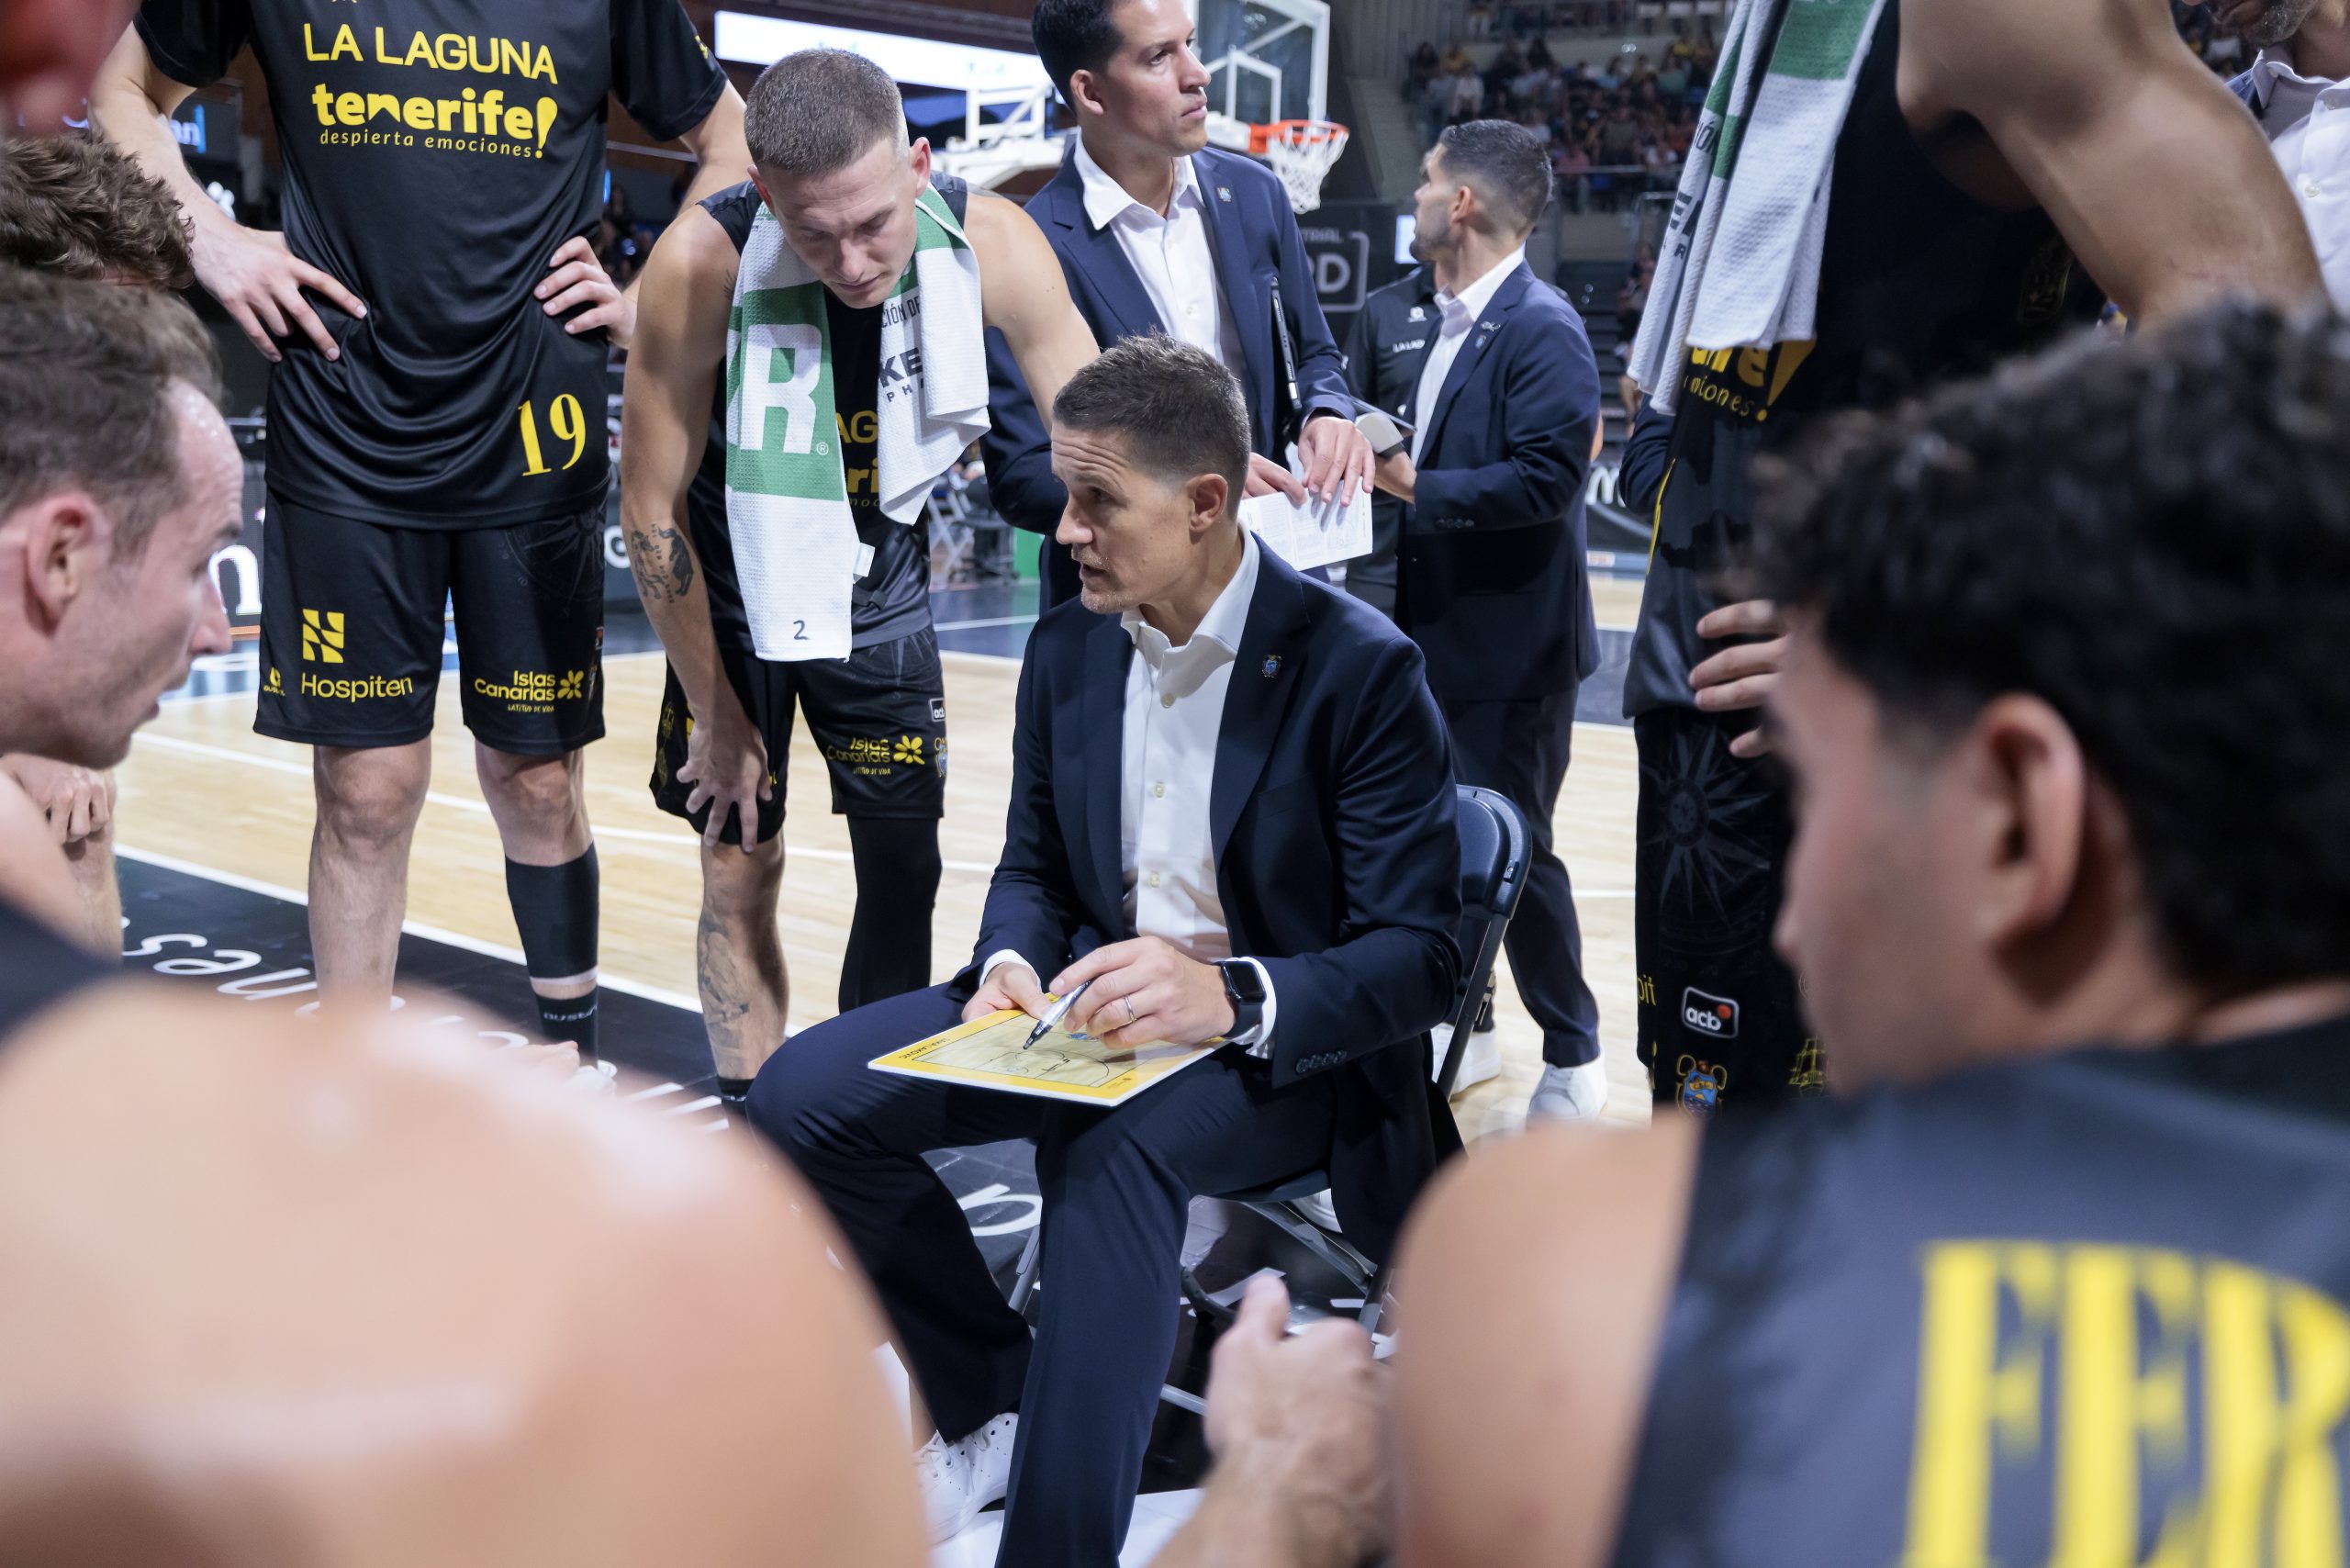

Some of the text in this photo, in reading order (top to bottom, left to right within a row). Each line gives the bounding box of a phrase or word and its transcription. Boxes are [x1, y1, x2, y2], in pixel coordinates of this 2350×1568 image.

[304, 23, 558, 84] LA LAGUNA
[319, 129, 414, 147] despierta
[740, 324, 822, 454] R
[518, 393, 587, 476] 19
[792, 619, 811, 641] 2
[301, 672, 413, 703] Hospiten
[475, 678, 556, 701] Canarias
[513, 670, 556, 688] Islas
[827, 745, 891, 764] Canarias
[849, 737, 890, 753] Islas
[1685, 1007, 1722, 1031] acb
